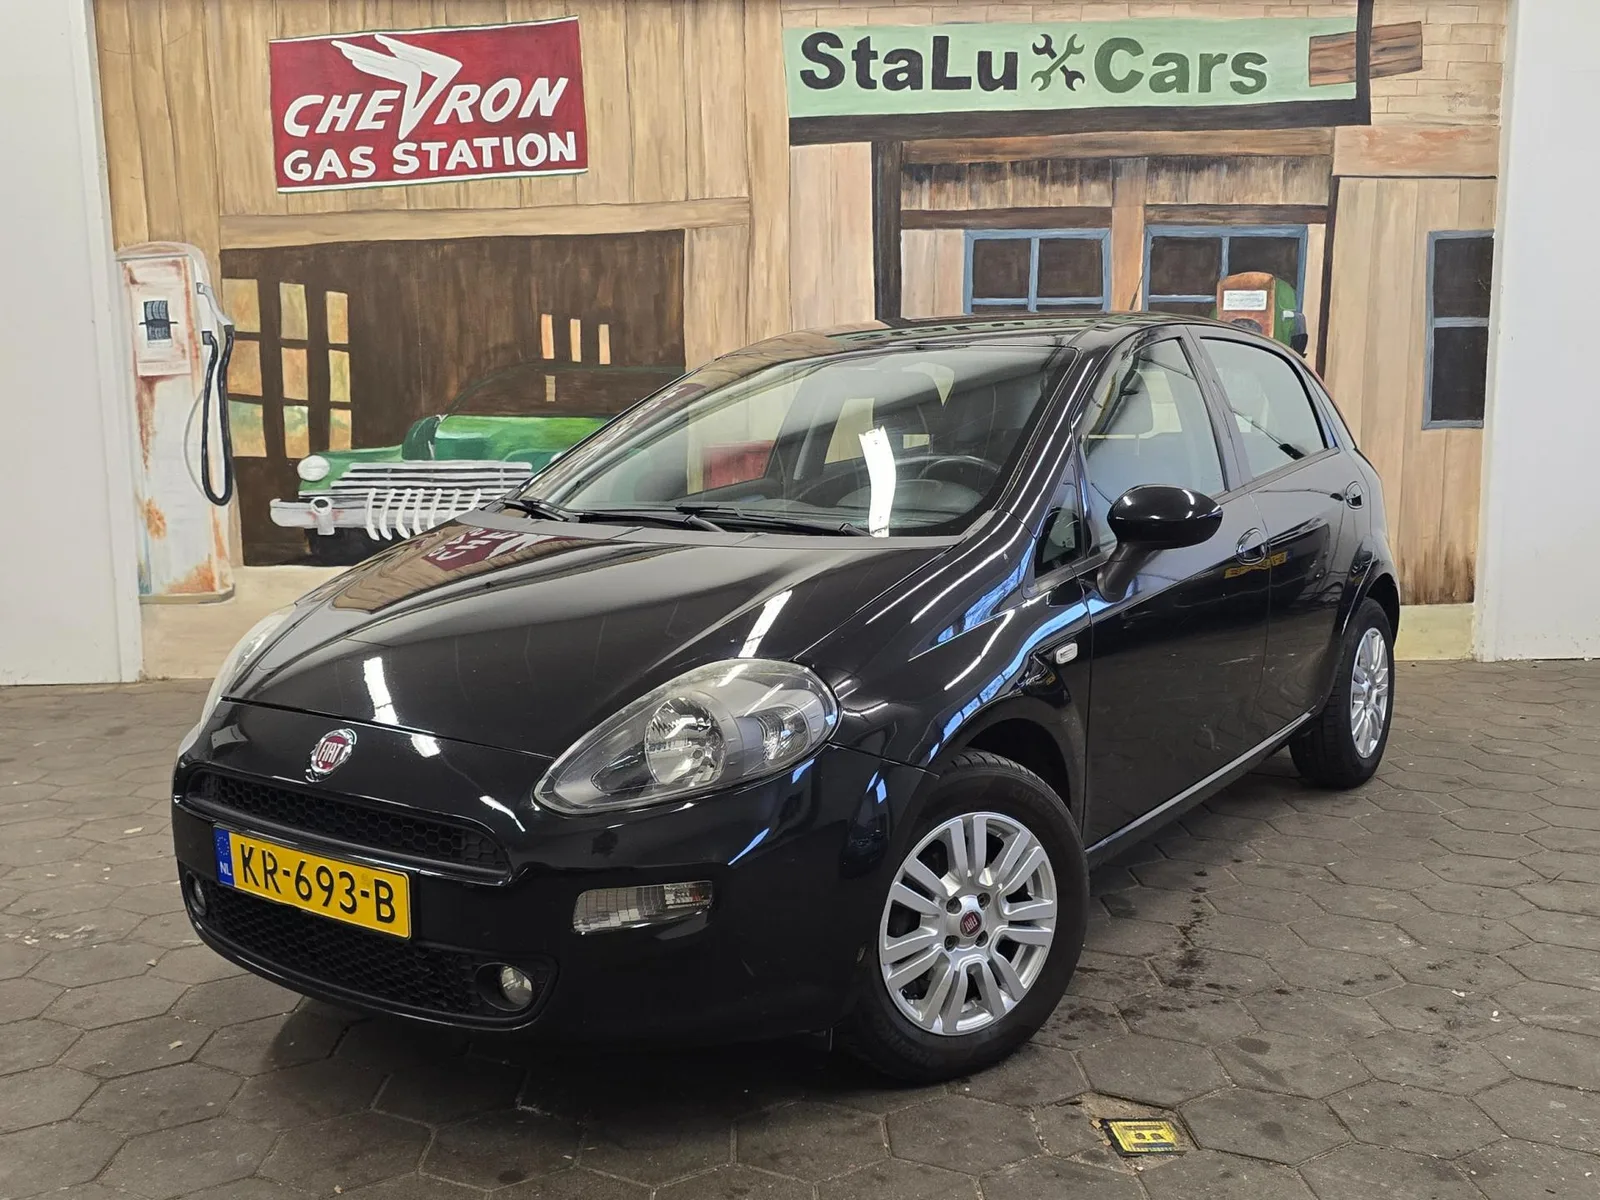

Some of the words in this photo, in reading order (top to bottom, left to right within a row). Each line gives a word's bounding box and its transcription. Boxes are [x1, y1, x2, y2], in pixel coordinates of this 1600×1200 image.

[799, 31, 1019, 92] StaLu
[1093, 36, 1269, 95] Cars
[282, 58, 569, 140] CHEVRON
[282, 148, 377, 182] GAS
[391, 130, 577, 176] STATION
[317, 741, 344, 763] FIAT
[219, 860, 233, 876] NL
[240, 843, 396, 924] KR-693-B
